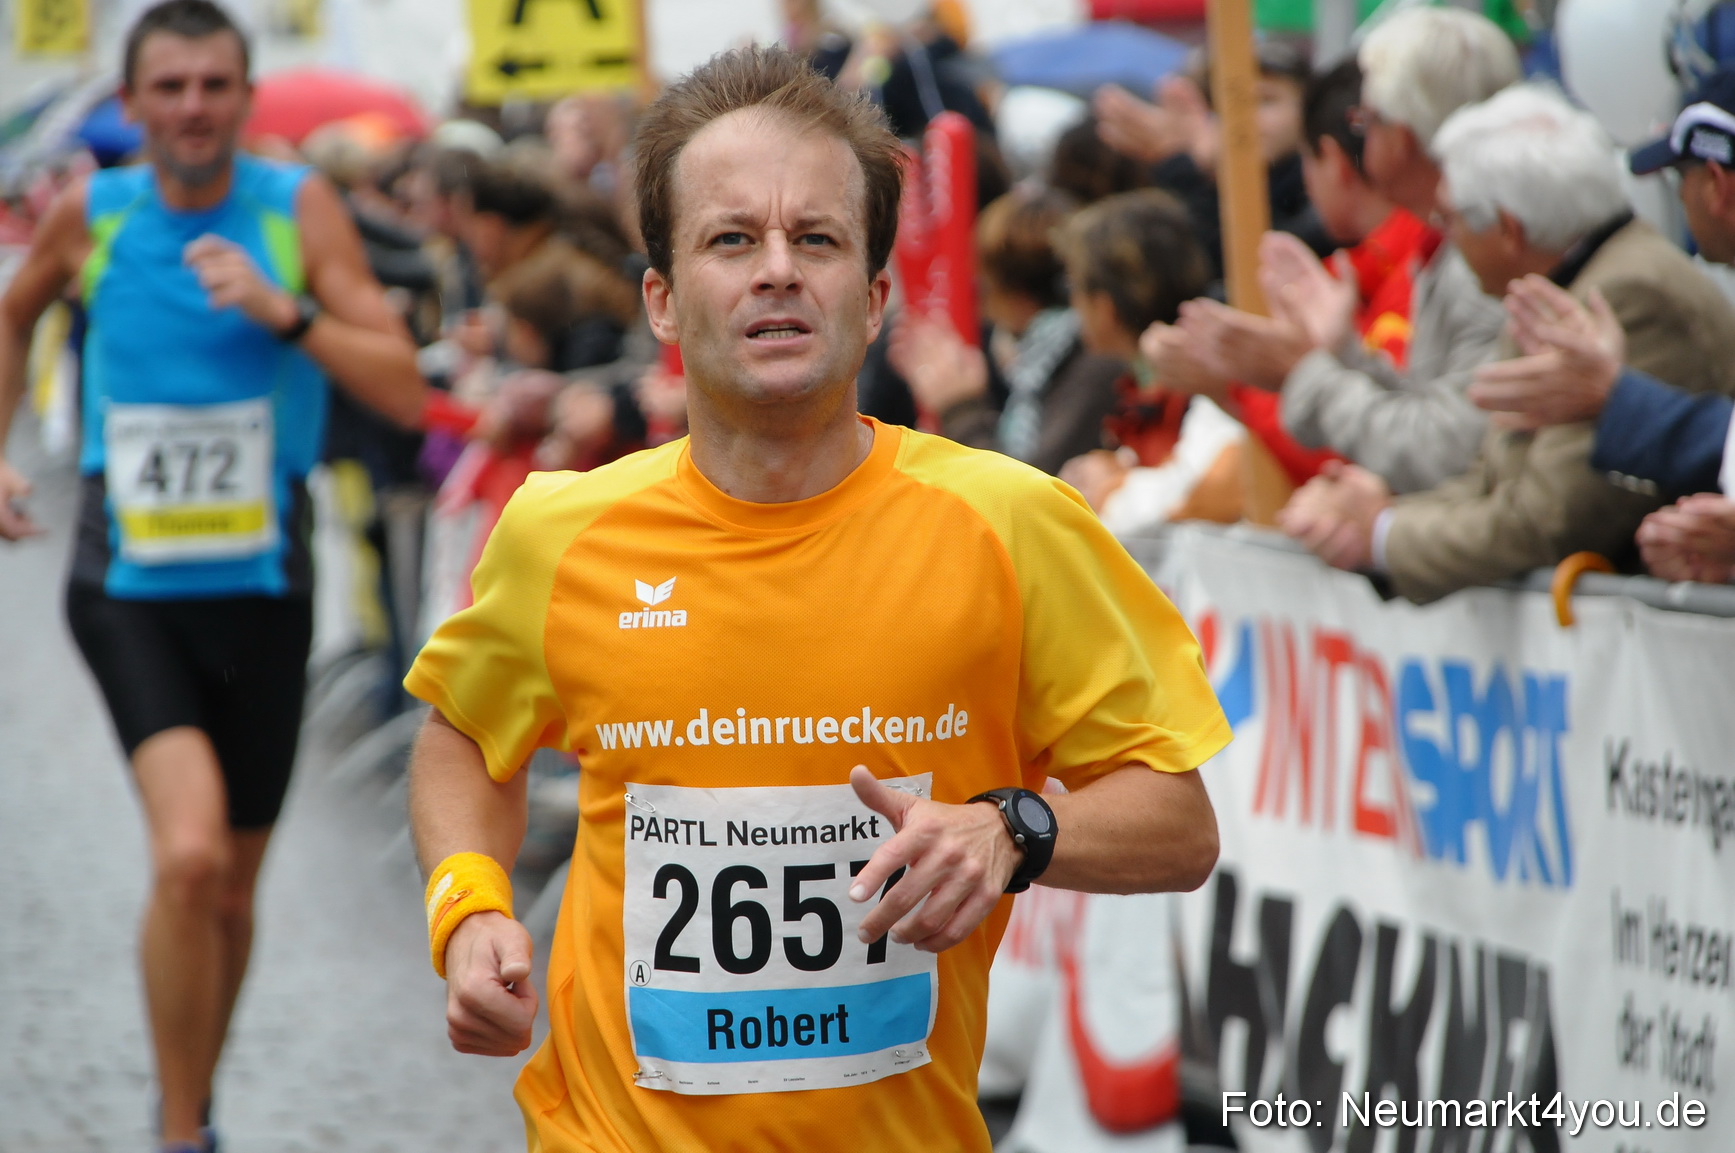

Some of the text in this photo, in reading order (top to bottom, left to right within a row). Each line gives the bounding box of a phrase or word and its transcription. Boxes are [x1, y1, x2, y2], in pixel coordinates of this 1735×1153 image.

[138, 438, 241, 497] 472
[618, 607, 687, 629] erima
[596, 703, 968, 749] www.deinruecken.de
[630, 815, 880, 847] PARTL Neumarkt
[652, 859, 907, 975] 2657
[635, 964, 646, 983] A
[706, 1003, 850, 1050] Robert
